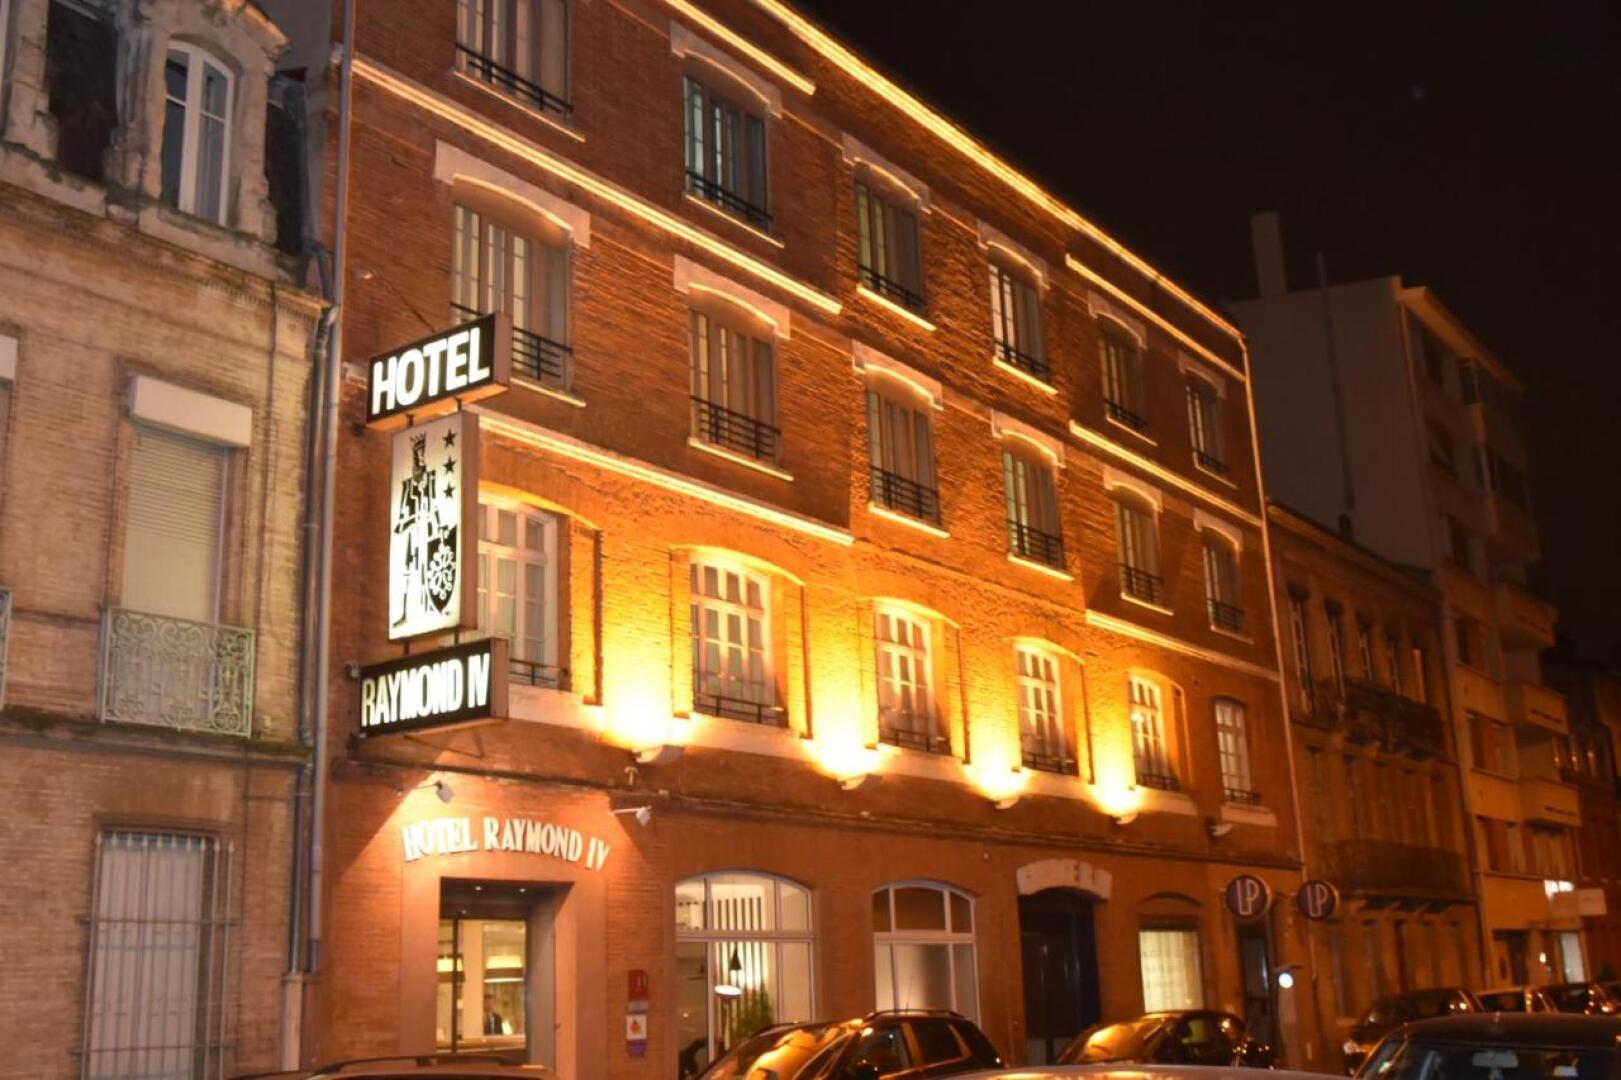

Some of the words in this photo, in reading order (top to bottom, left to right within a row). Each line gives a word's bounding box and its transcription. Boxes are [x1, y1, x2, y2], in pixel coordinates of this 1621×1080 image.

[371, 327, 490, 415] HOTEL
[361, 658, 463, 727] RAYMOND
[467, 652, 490, 708] IV
[402, 817, 478, 862] HOTEL
[483, 817, 583, 862] RAYMOND
[585, 837, 610, 872] IV
